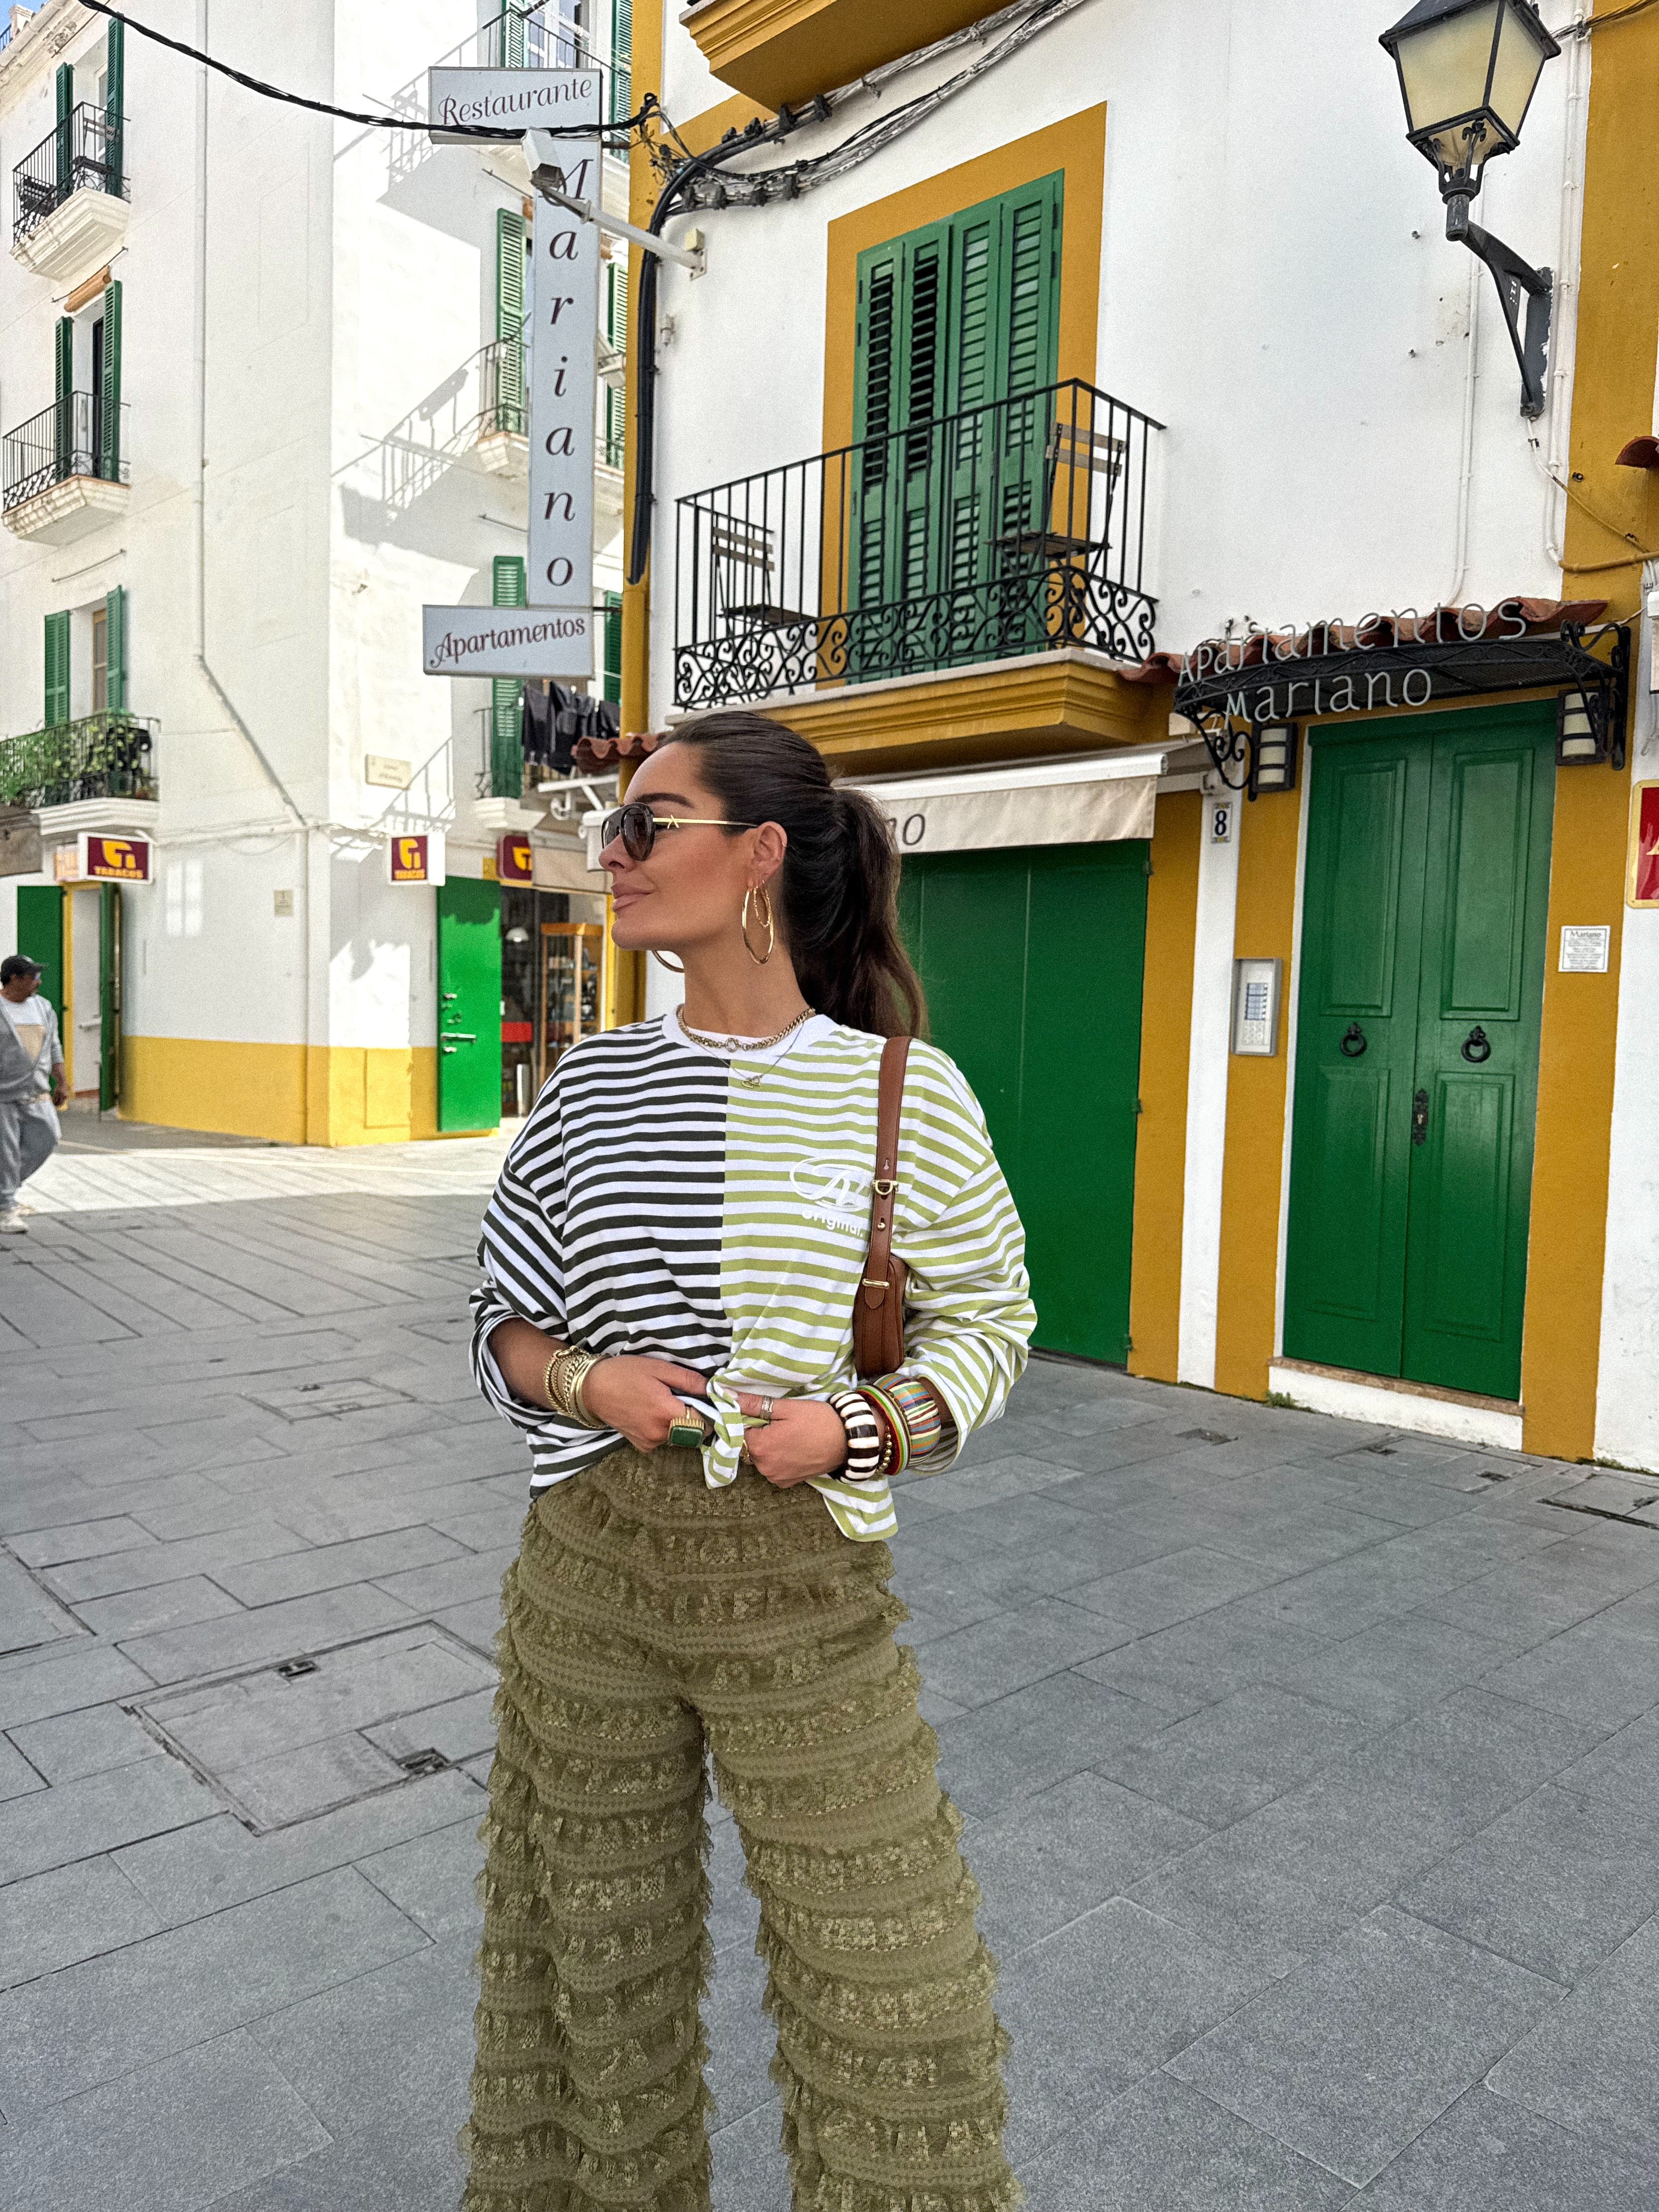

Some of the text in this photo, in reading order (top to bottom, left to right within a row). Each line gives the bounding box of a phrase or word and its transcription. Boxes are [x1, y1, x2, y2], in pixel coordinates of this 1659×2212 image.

[438, 78, 592, 126] Restaurante
[430, 616, 585, 669] Apartamentos
[1178, 601, 1527, 687] Apartamentos
[1224, 668, 1432, 727] Mariano
[1215, 810, 1227, 836] 8
